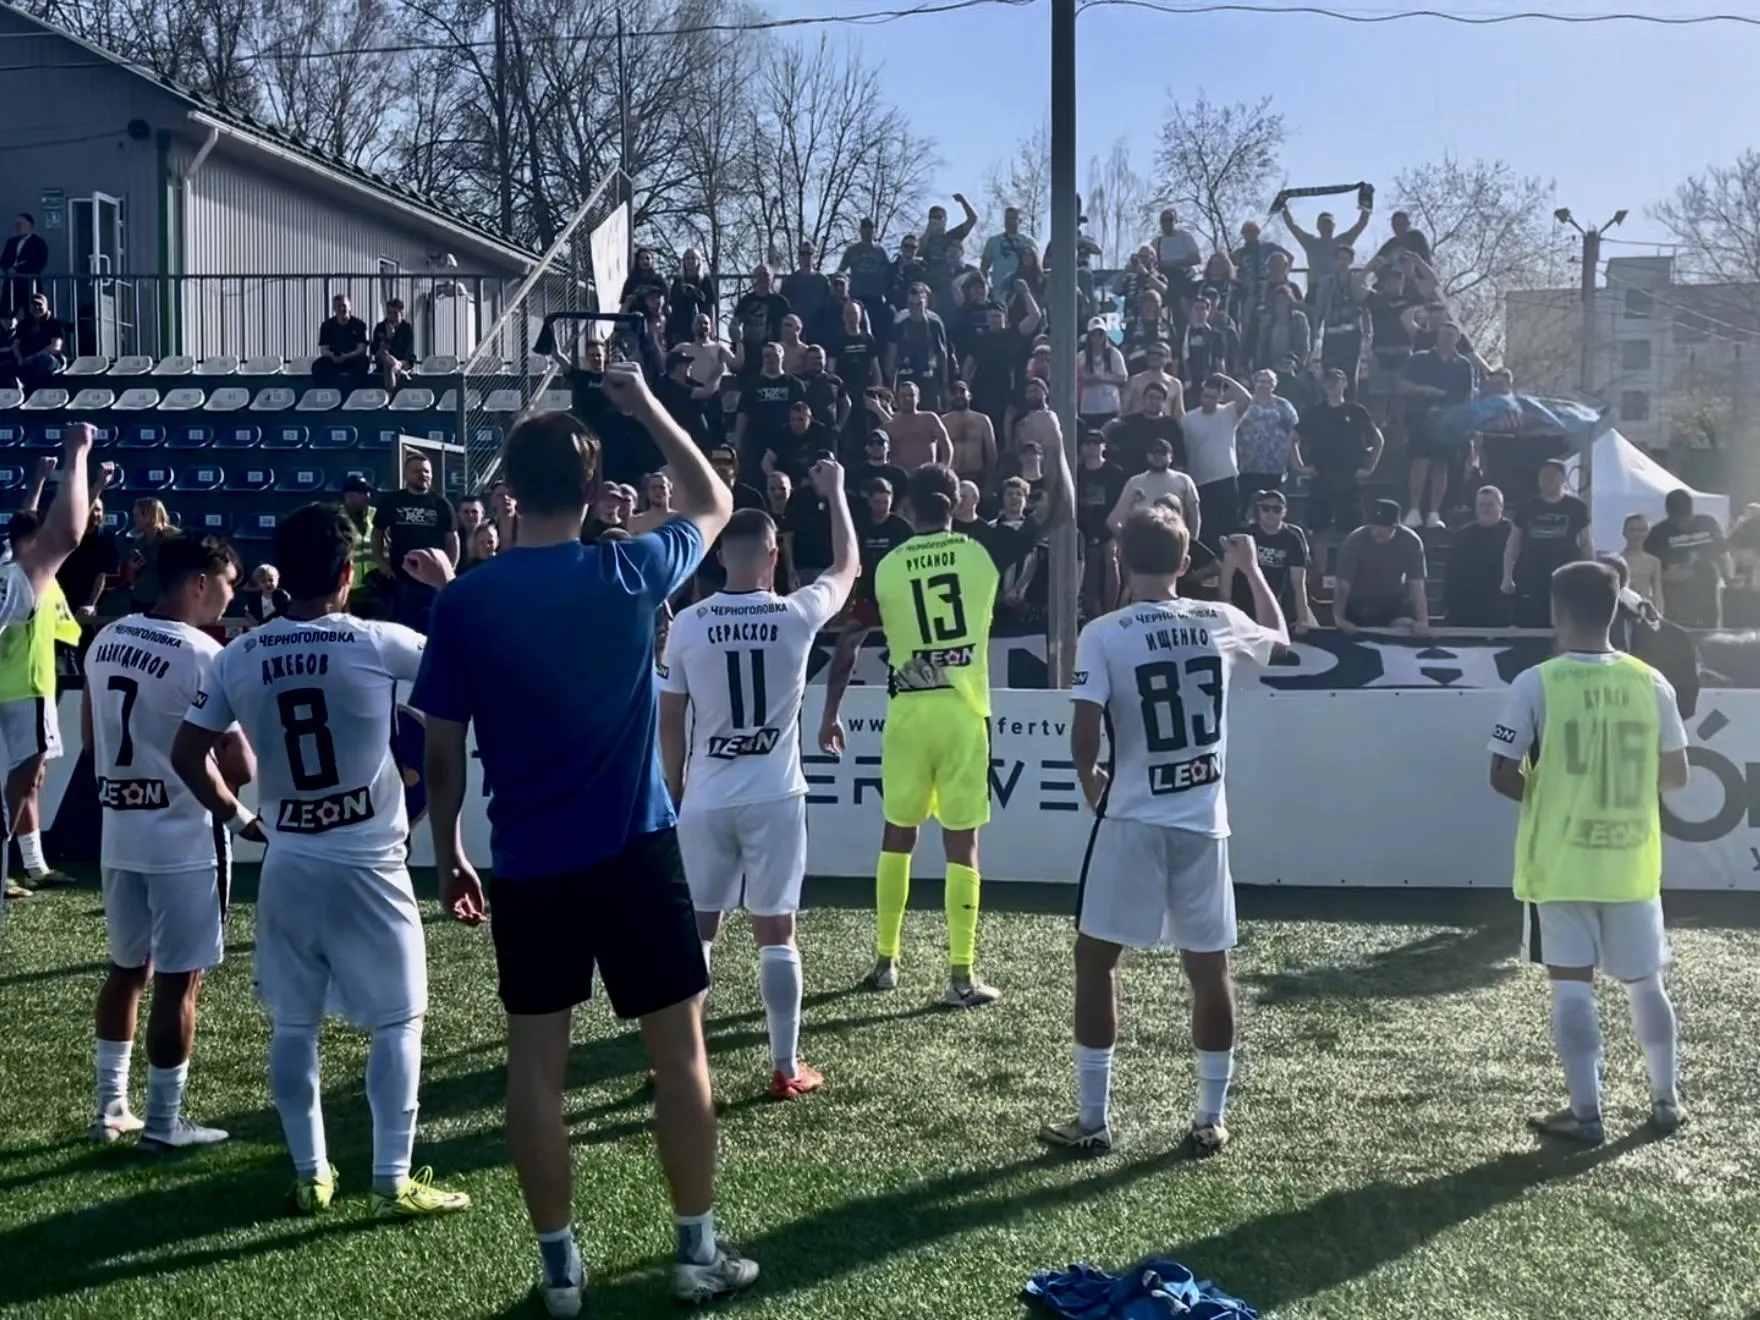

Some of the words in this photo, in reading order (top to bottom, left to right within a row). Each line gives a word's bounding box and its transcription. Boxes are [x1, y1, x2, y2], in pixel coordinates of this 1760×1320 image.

[906, 551, 956, 572] РУСАНОВ
[707, 622, 779, 645] СЕРАСХОВ
[711, 602, 788, 617] ЧЕРНОГОЛОВКА
[910, 572, 968, 645] 13
[259, 630, 356, 648] ЧЕРНОГОЛОВКА
[1144, 628, 1209, 652] ИЩЕНКО
[725, 648, 767, 729] 11
[1135, 655, 1222, 753] 83
[107, 675, 139, 767] 7
[277, 687, 339, 791] 8
[1563, 719, 1651, 810] 46
[280, 790, 369, 829] LEON
